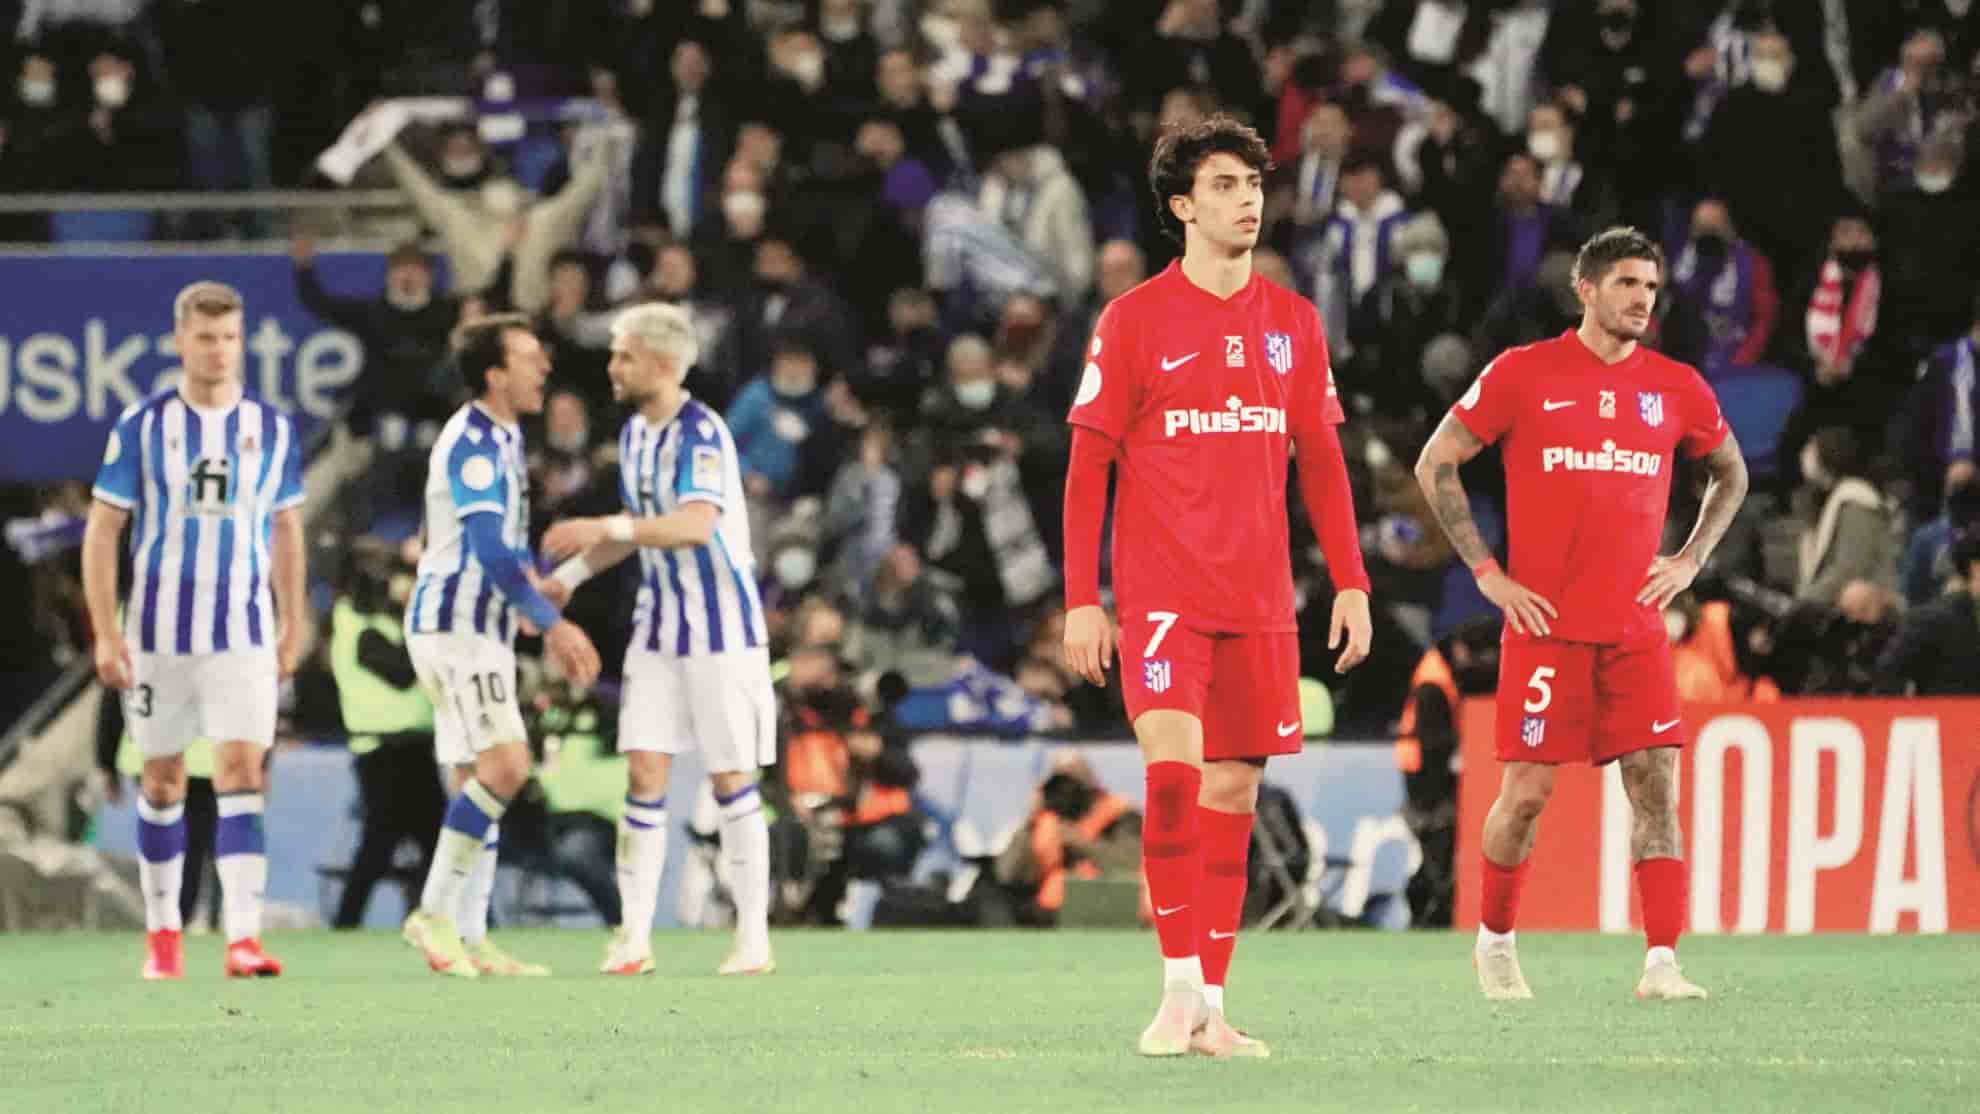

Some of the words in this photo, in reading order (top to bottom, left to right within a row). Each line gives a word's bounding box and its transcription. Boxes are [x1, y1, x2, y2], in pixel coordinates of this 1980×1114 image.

[1143, 611, 1179, 658] 7
[471, 671, 507, 705] 10
[1524, 666, 1556, 712] 5
